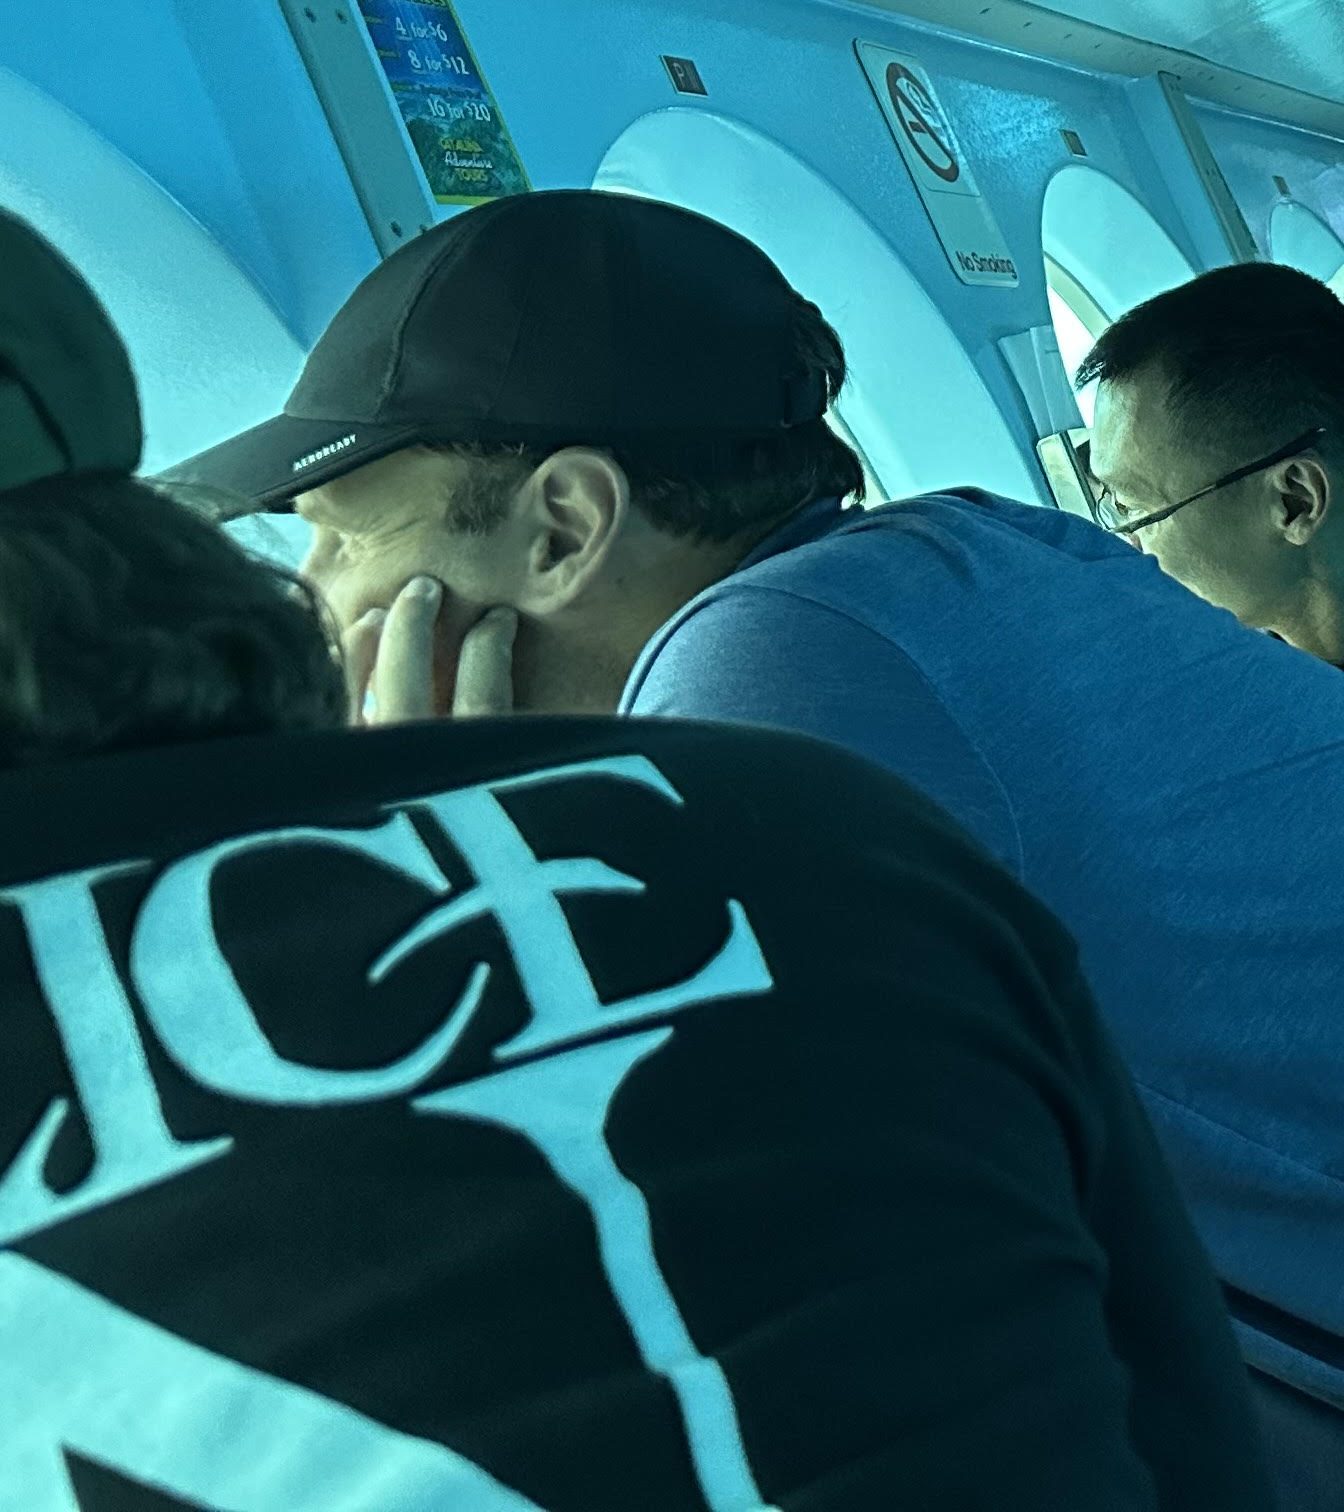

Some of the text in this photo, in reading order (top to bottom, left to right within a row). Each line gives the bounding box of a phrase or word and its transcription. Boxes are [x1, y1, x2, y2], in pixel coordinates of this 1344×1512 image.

[395, 16, 407, 36] 4
[407, 49, 422, 69] 8
[442, 53, 470, 75] $12
[427, 94, 446, 117] 16
[464, 100, 491, 122] $20
[955, 250, 1018, 280] No Smoking
[293, 433, 357, 473] AEROREADY
